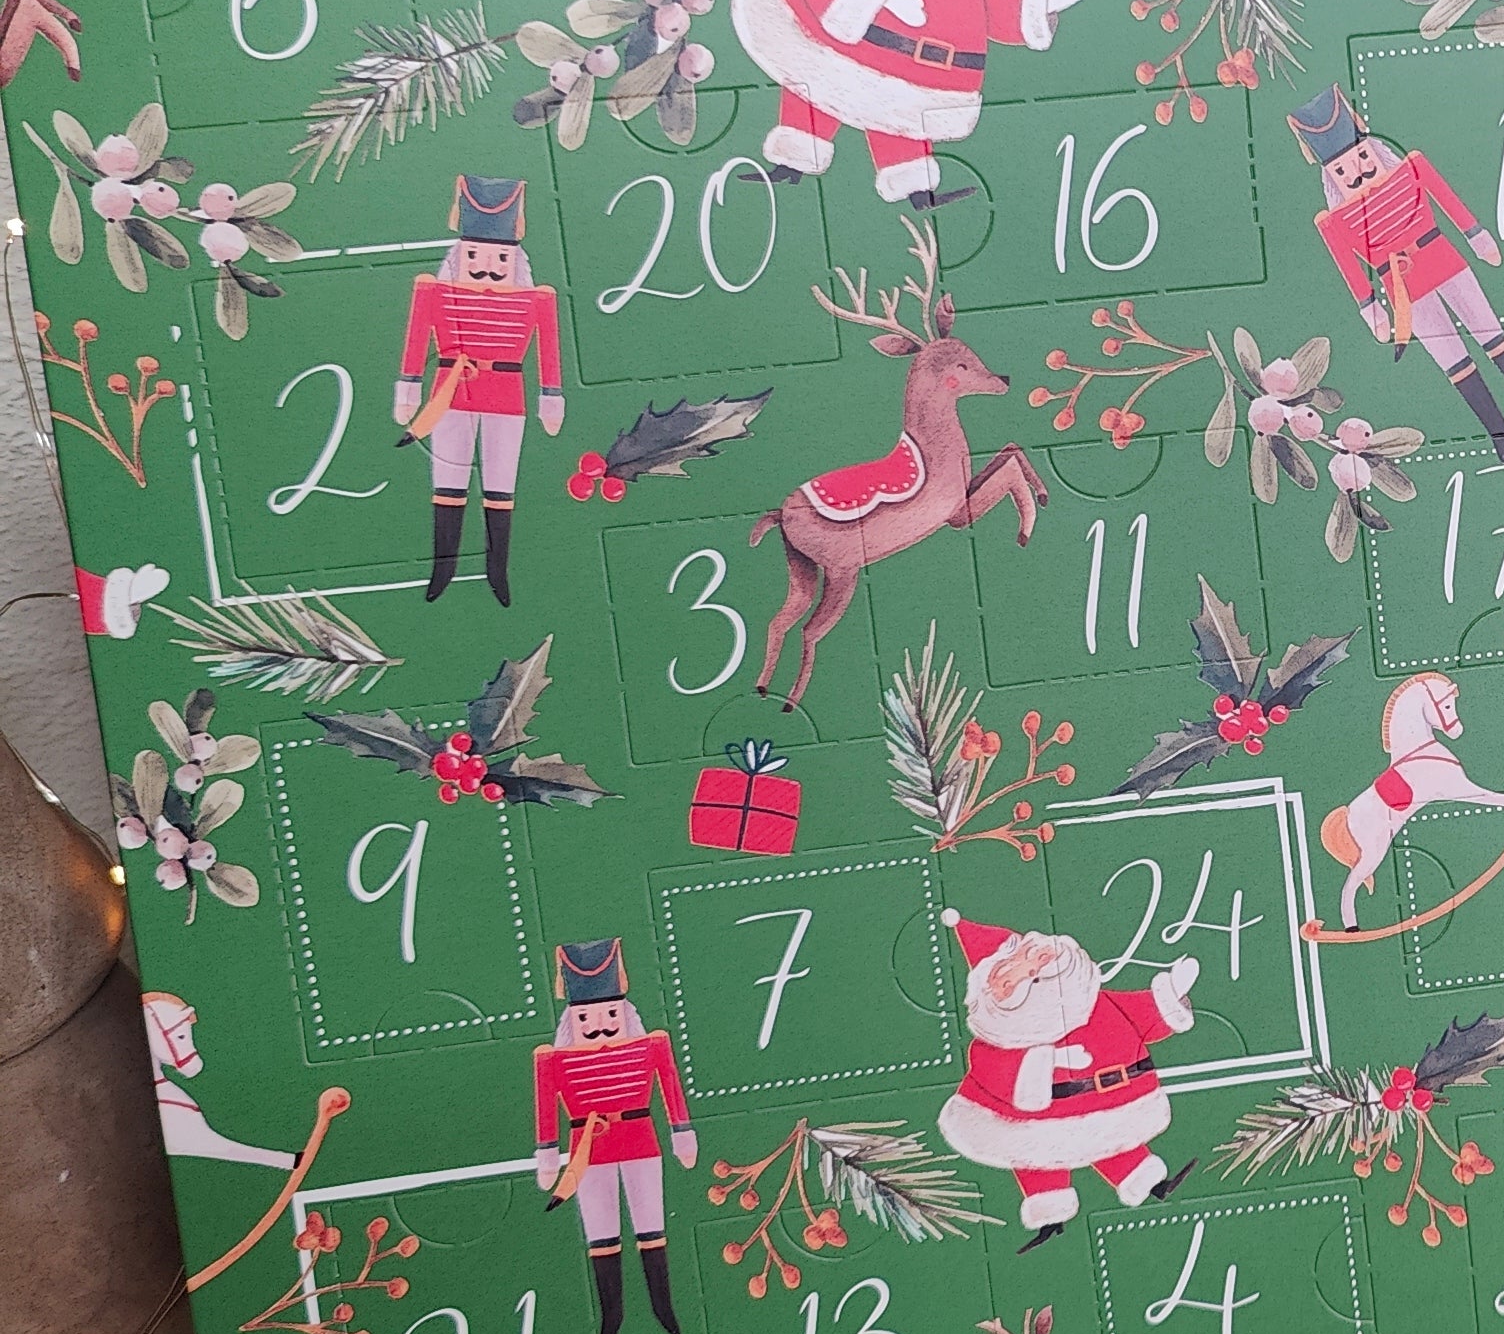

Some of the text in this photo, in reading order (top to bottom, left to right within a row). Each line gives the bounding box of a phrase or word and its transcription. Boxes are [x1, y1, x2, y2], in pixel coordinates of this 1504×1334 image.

[597, 155, 776, 313] 20
[1053, 124, 1159, 275] 16
[267, 363, 389, 515] 2
[668, 549, 747, 695] 3
[1084, 514, 1148, 654] 11
[347, 820, 428, 963] 9
[1097, 849, 1264, 982] 24
[735, 908, 812, 1049] 7
